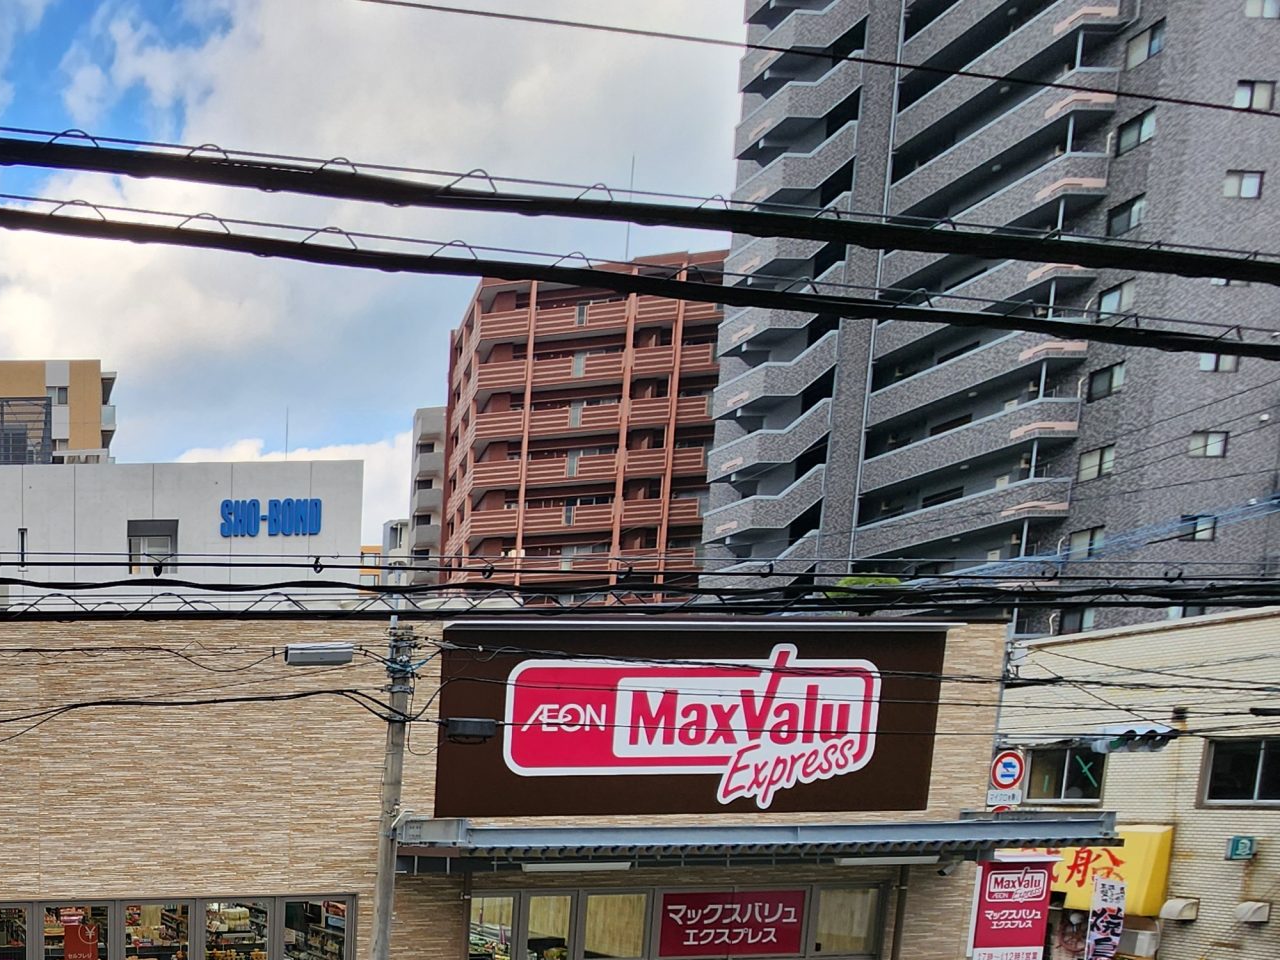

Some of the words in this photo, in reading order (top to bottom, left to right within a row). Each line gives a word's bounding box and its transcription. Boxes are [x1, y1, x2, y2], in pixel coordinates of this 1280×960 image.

[220, 498, 322, 538] SHO-BOND
[628, 651, 851, 746] MaxValu
[721, 739, 856, 804] Express
[993, 867, 1041, 889] MaxValu
[667, 902, 798, 925] マックスバリュ
[984, 909, 1042, 920] マックスバリュ
[990, 920, 1033, 929] エクスプレス
[683, 927, 777, 945] エクスプレス
